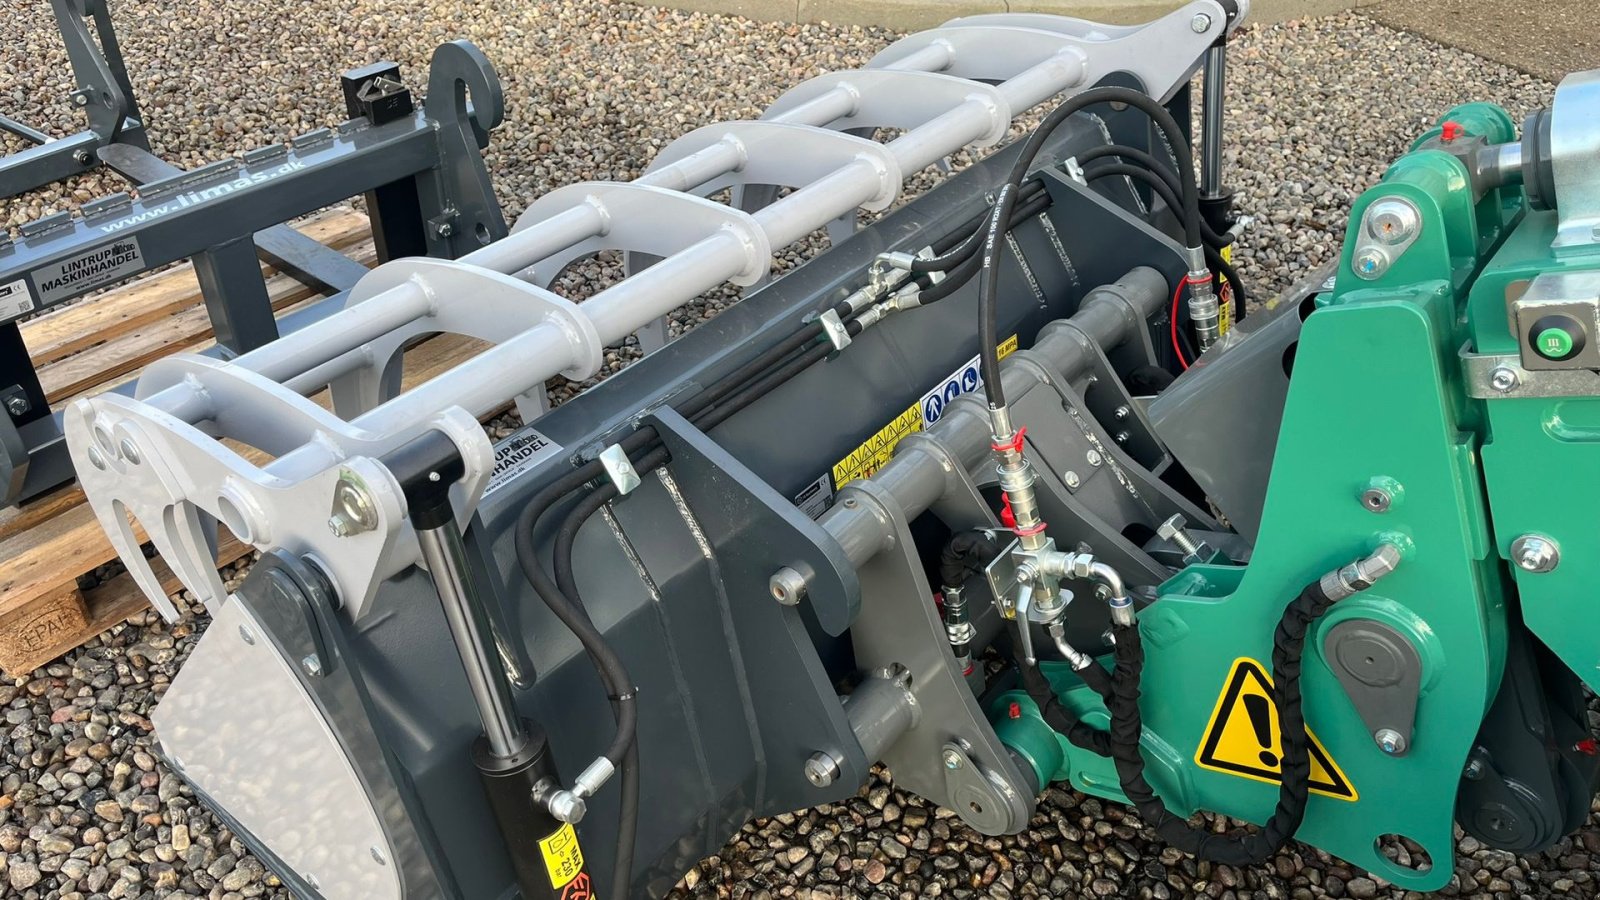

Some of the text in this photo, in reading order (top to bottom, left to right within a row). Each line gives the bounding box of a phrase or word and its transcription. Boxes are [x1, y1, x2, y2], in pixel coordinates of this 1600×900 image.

[102, 161, 305, 233] www.limas.dk
[41, 250, 139, 293] MASKINHANDEL
[61, 249, 111, 274] LINTRUP
[562, 857, 574, 876] 230
[570, 845, 581, 870] MAX
